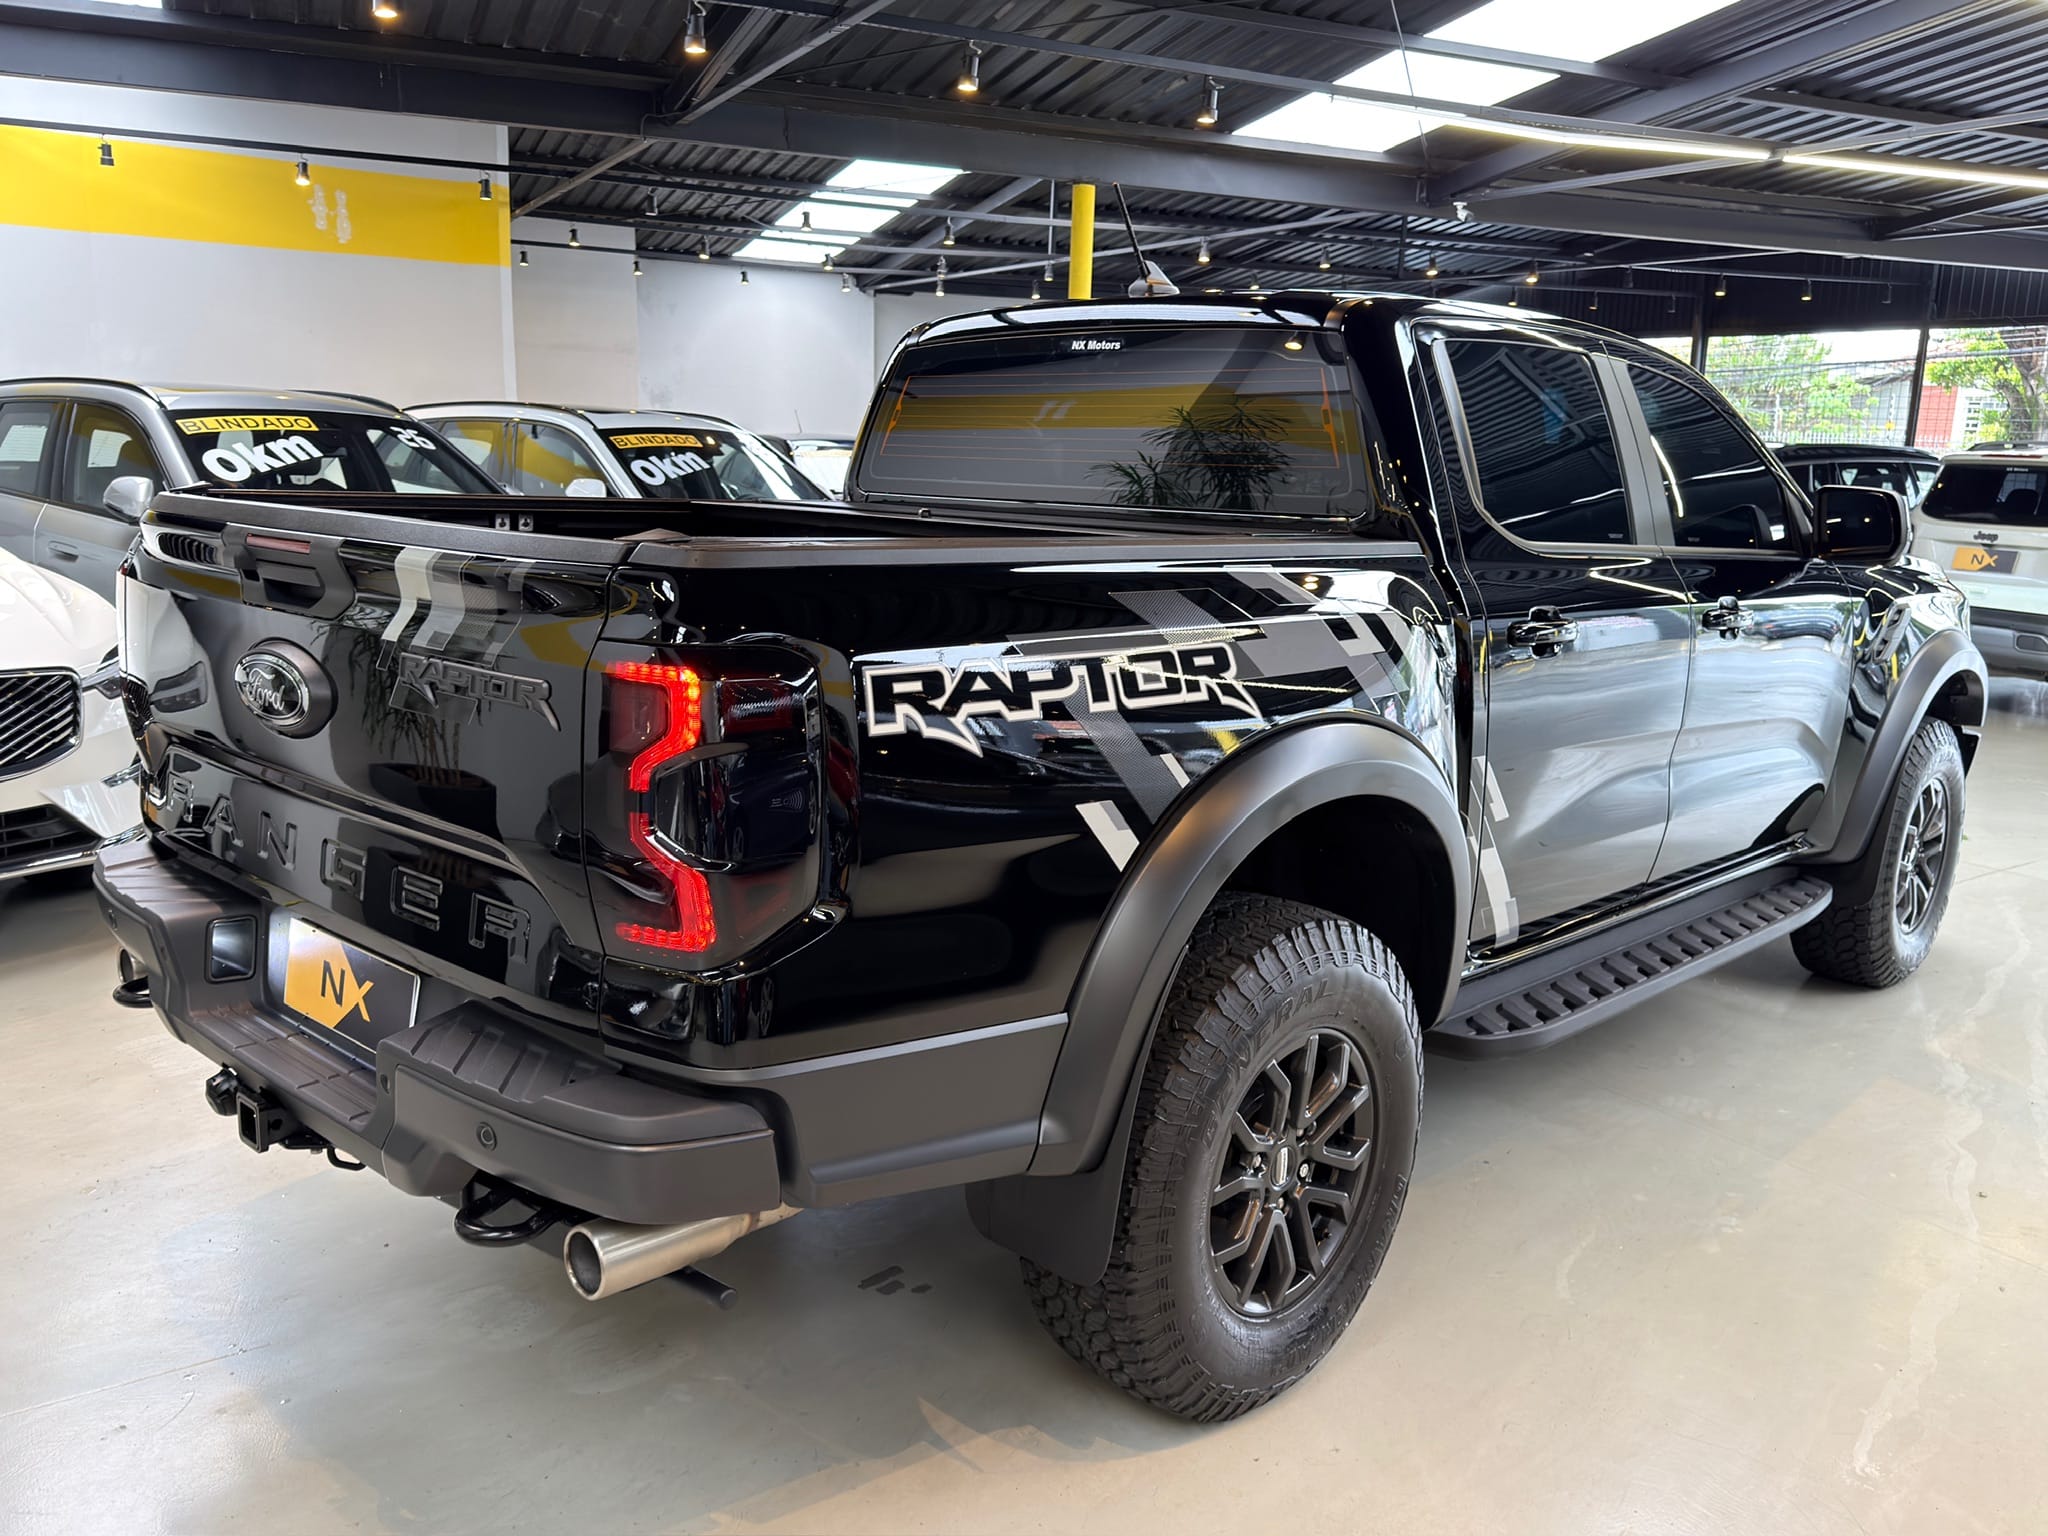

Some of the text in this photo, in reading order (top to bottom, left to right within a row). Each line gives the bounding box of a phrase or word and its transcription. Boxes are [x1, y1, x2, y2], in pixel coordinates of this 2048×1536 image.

[1071, 340, 1121, 350] NX Motors
[180, 418, 312, 434] BLINDADO
[612, 434, 699, 448] BLINDADO
[1970, 554, 1999, 568] NX
[243, 667, 286, 712] Ford
[400, 651, 562, 732] RAPTOR
[862, 643, 1265, 758] RAPTOR
[167, 771, 531, 964] RANGER
[319, 958, 374, 1023] NX
